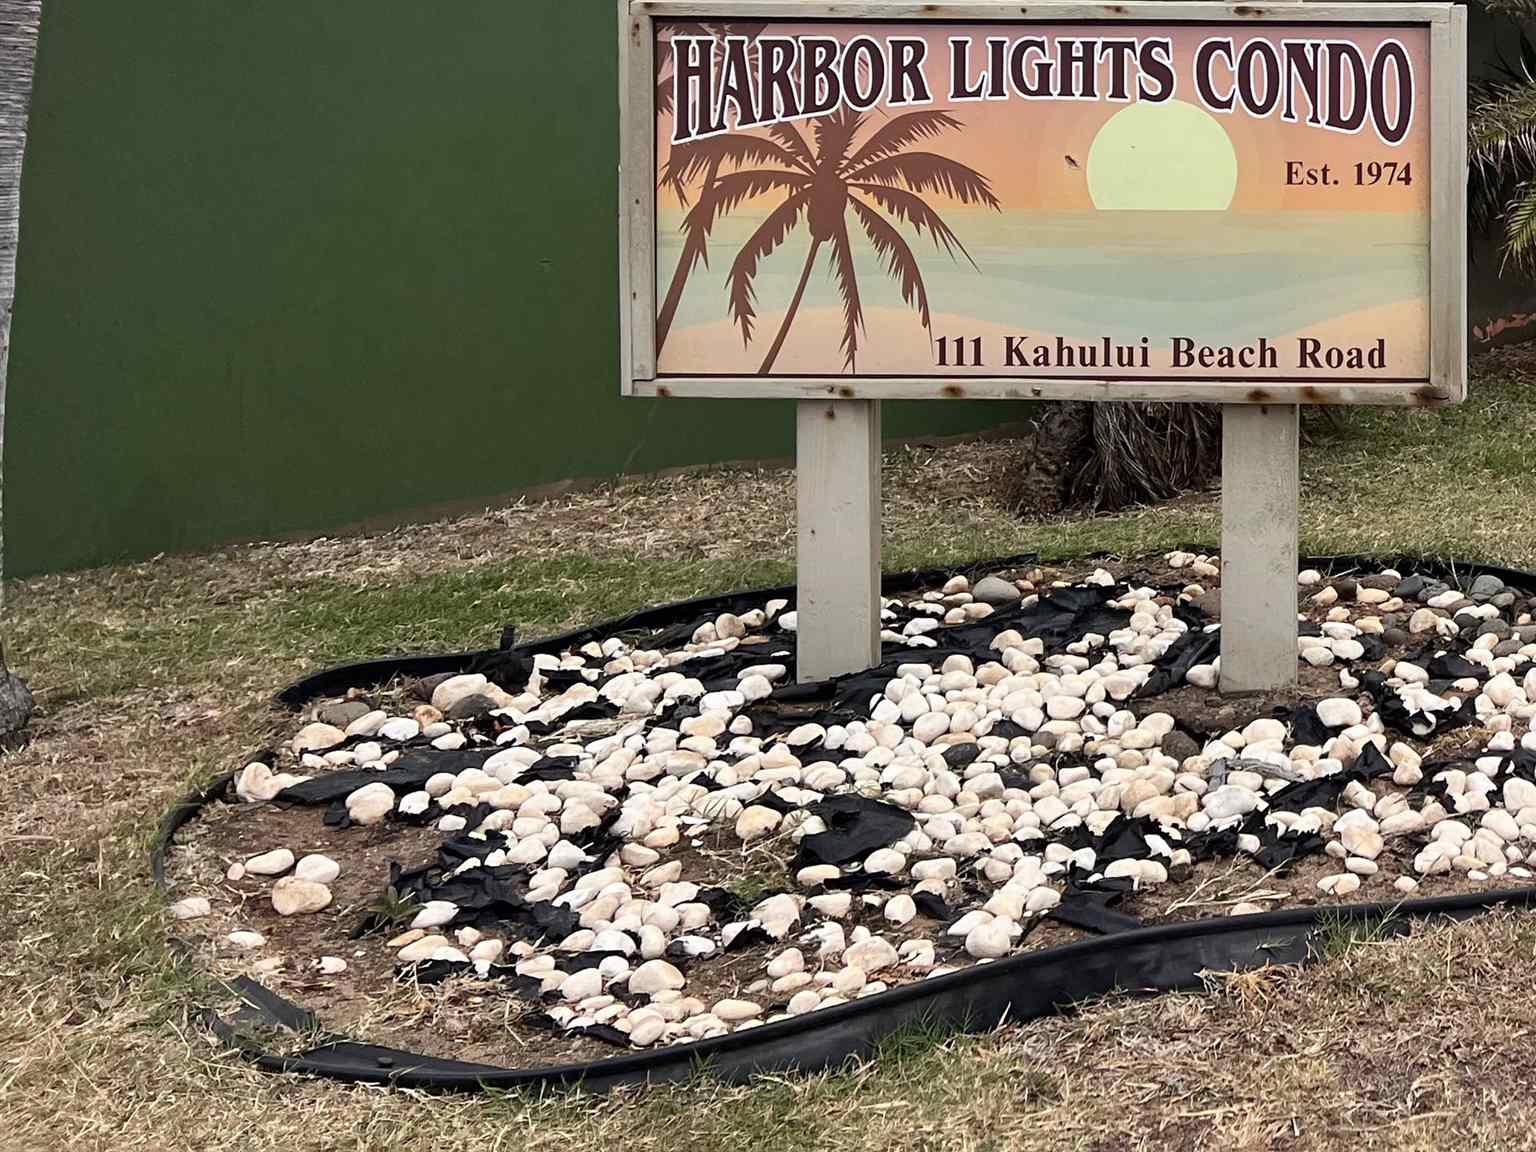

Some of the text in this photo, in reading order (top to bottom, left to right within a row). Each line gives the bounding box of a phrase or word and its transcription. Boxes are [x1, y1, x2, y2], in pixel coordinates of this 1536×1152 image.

[671, 35, 1415, 146] HARBOR LIGHTS CONDO
[1285, 161, 1413, 186] Est. 1974
[934, 336, 1387, 369] 111 Kahului Beach Road
